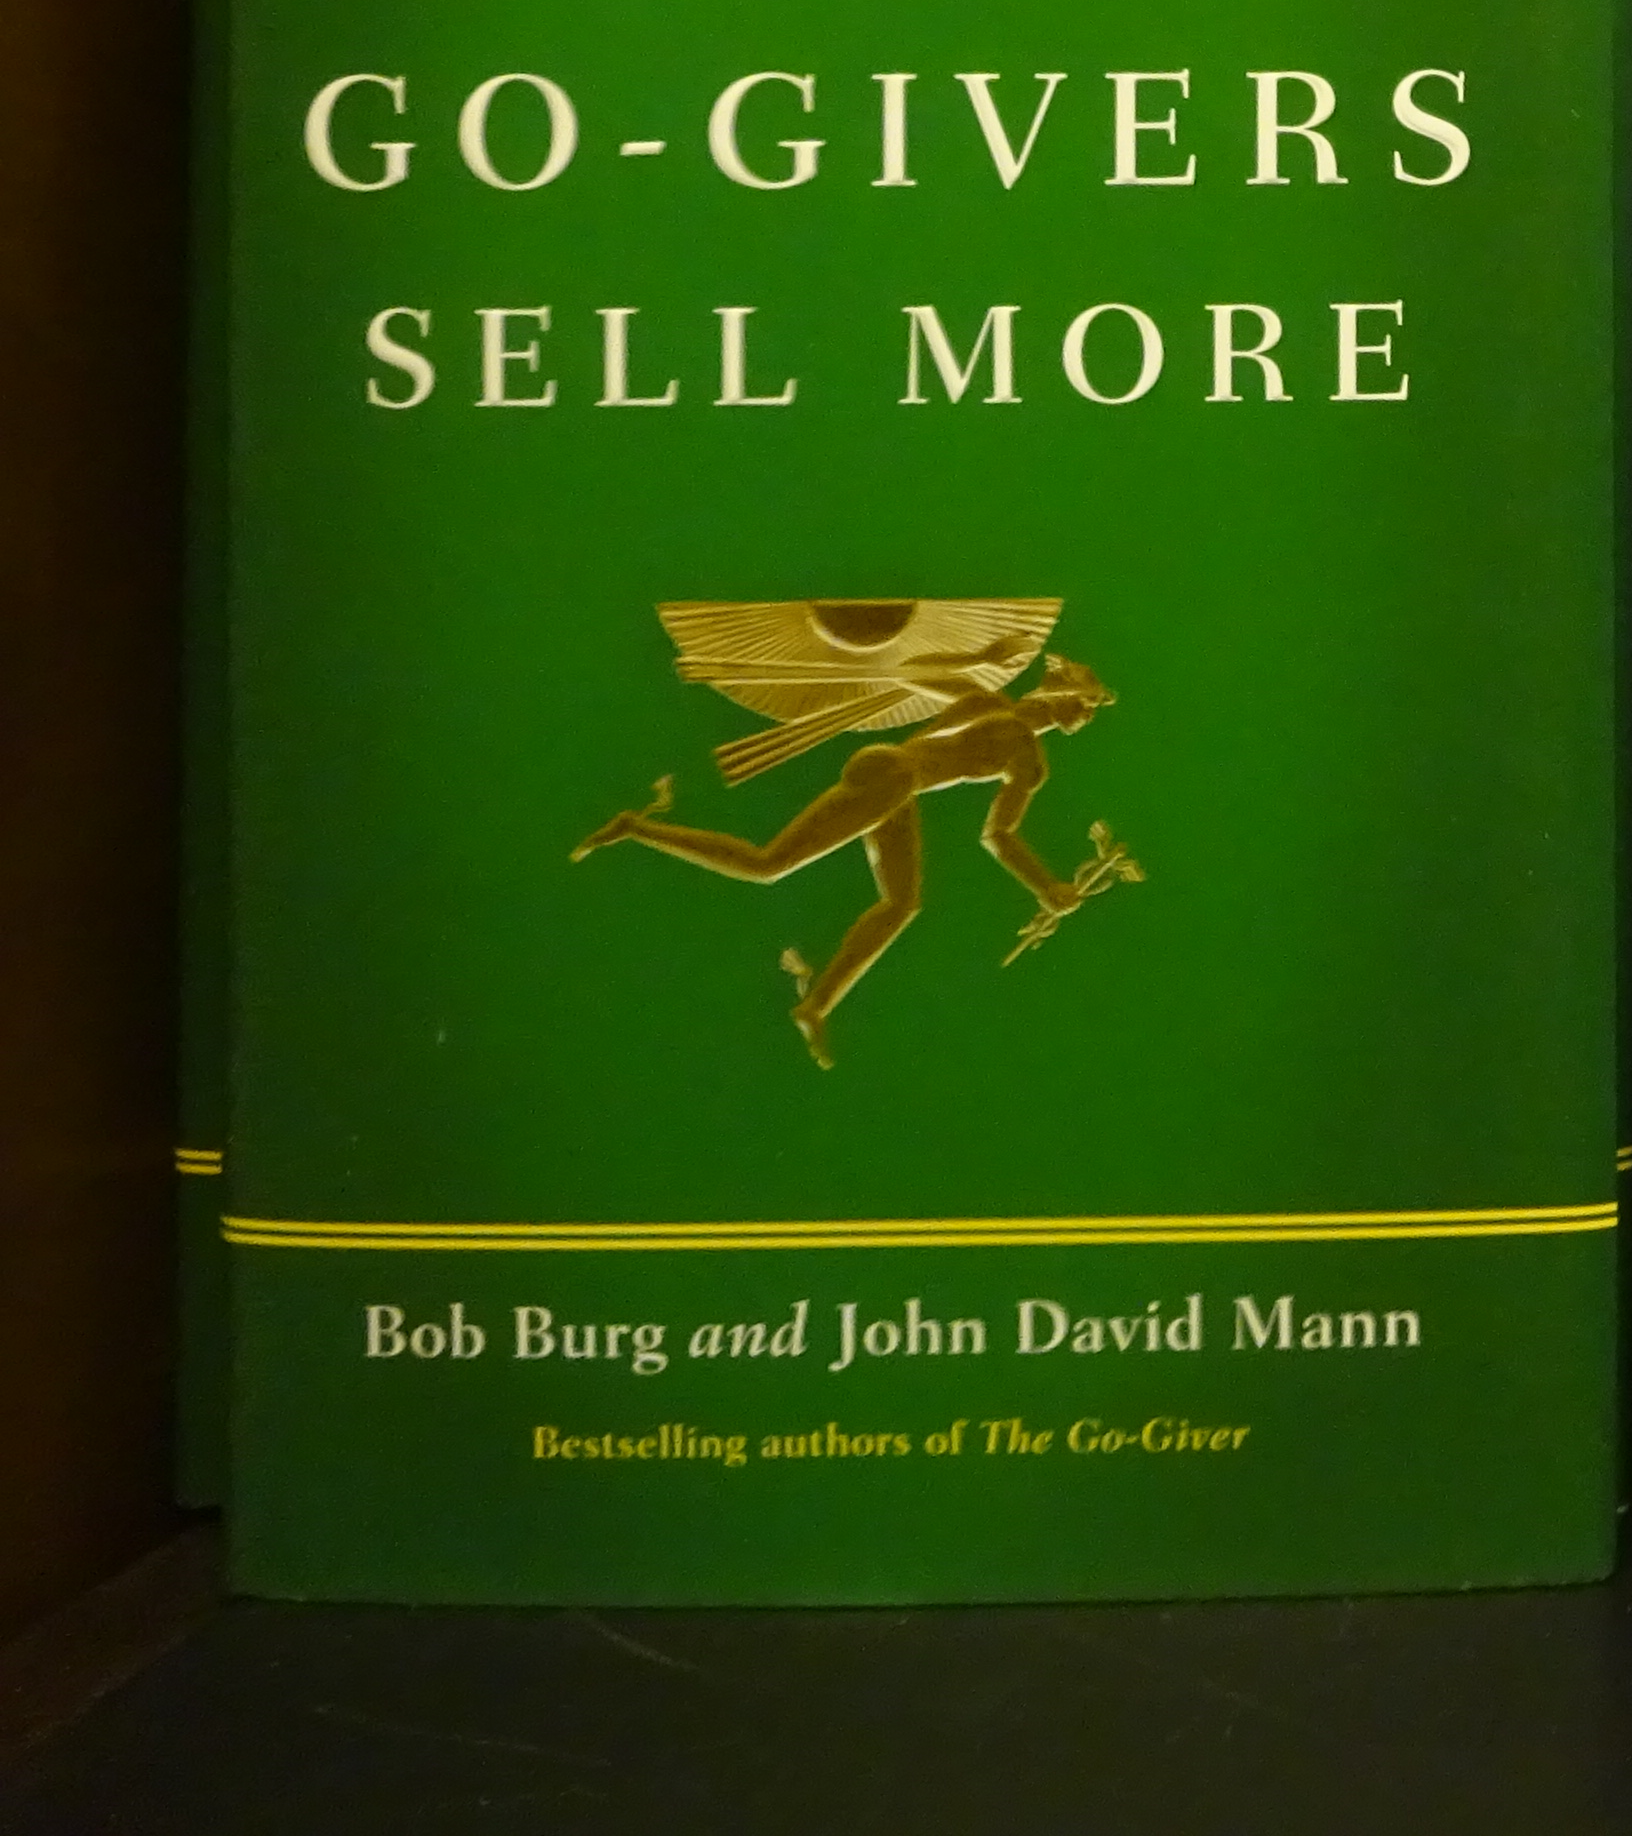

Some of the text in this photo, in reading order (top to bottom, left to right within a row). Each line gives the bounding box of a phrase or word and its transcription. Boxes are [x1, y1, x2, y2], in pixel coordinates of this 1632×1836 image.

[305, 68, 1471, 192] GO-GIVERS
[366, 299, 1409, 409] SELL MORE
[366, 1293, 1420, 1375] Bob Burg and John David Mann
[534, 1417, 1250, 1467] Bestselling authors of The Go-Giver
